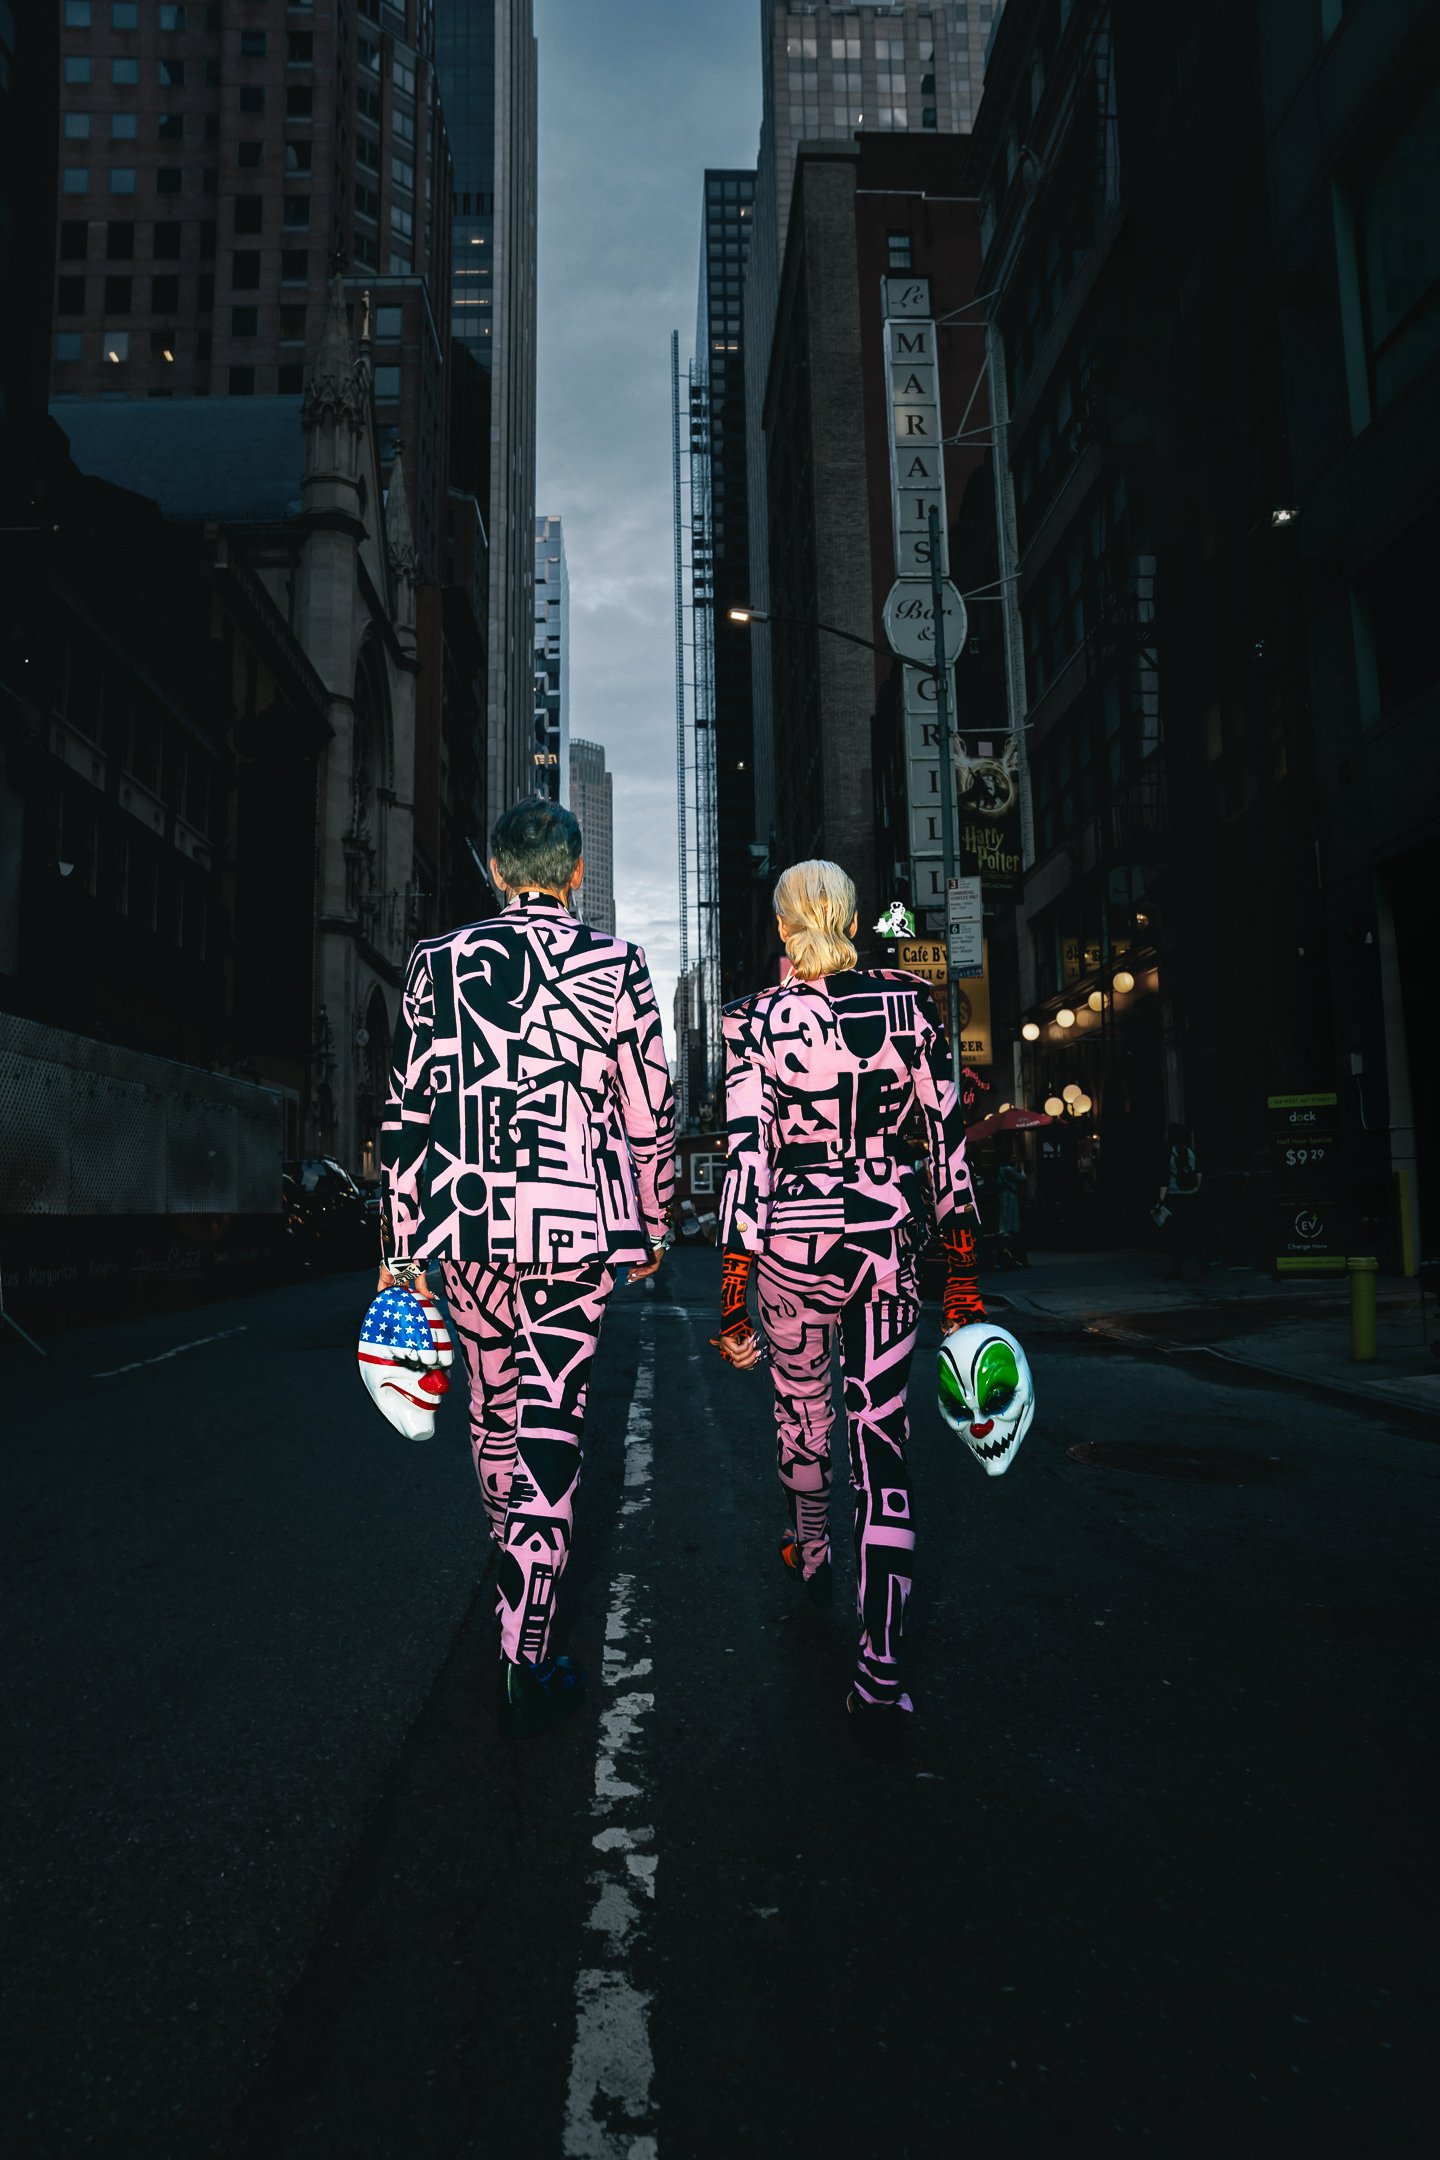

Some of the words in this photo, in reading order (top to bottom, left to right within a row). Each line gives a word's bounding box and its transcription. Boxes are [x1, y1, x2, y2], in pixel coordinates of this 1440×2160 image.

[891, 285, 924, 309] Le
[896, 333, 932, 563] MARAIS
[895, 600, 953, 620] Bar
[916, 678, 948, 895] GRILL
[962, 825, 1005, 853] Harry
[977, 846, 1020, 873] Potter
[950, 880, 957, 889] 3
[951, 925, 958, 934] 6
[903, 946, 929, 962] Café
[936, 969, 945, 980] &
[960, 1041, 984, 1052] EER
[1289, 1110, 1317, 1122] dock
[1301, 1218, 1317, 1231] EV
[1287, 1243, 1310, 1251] Charge
